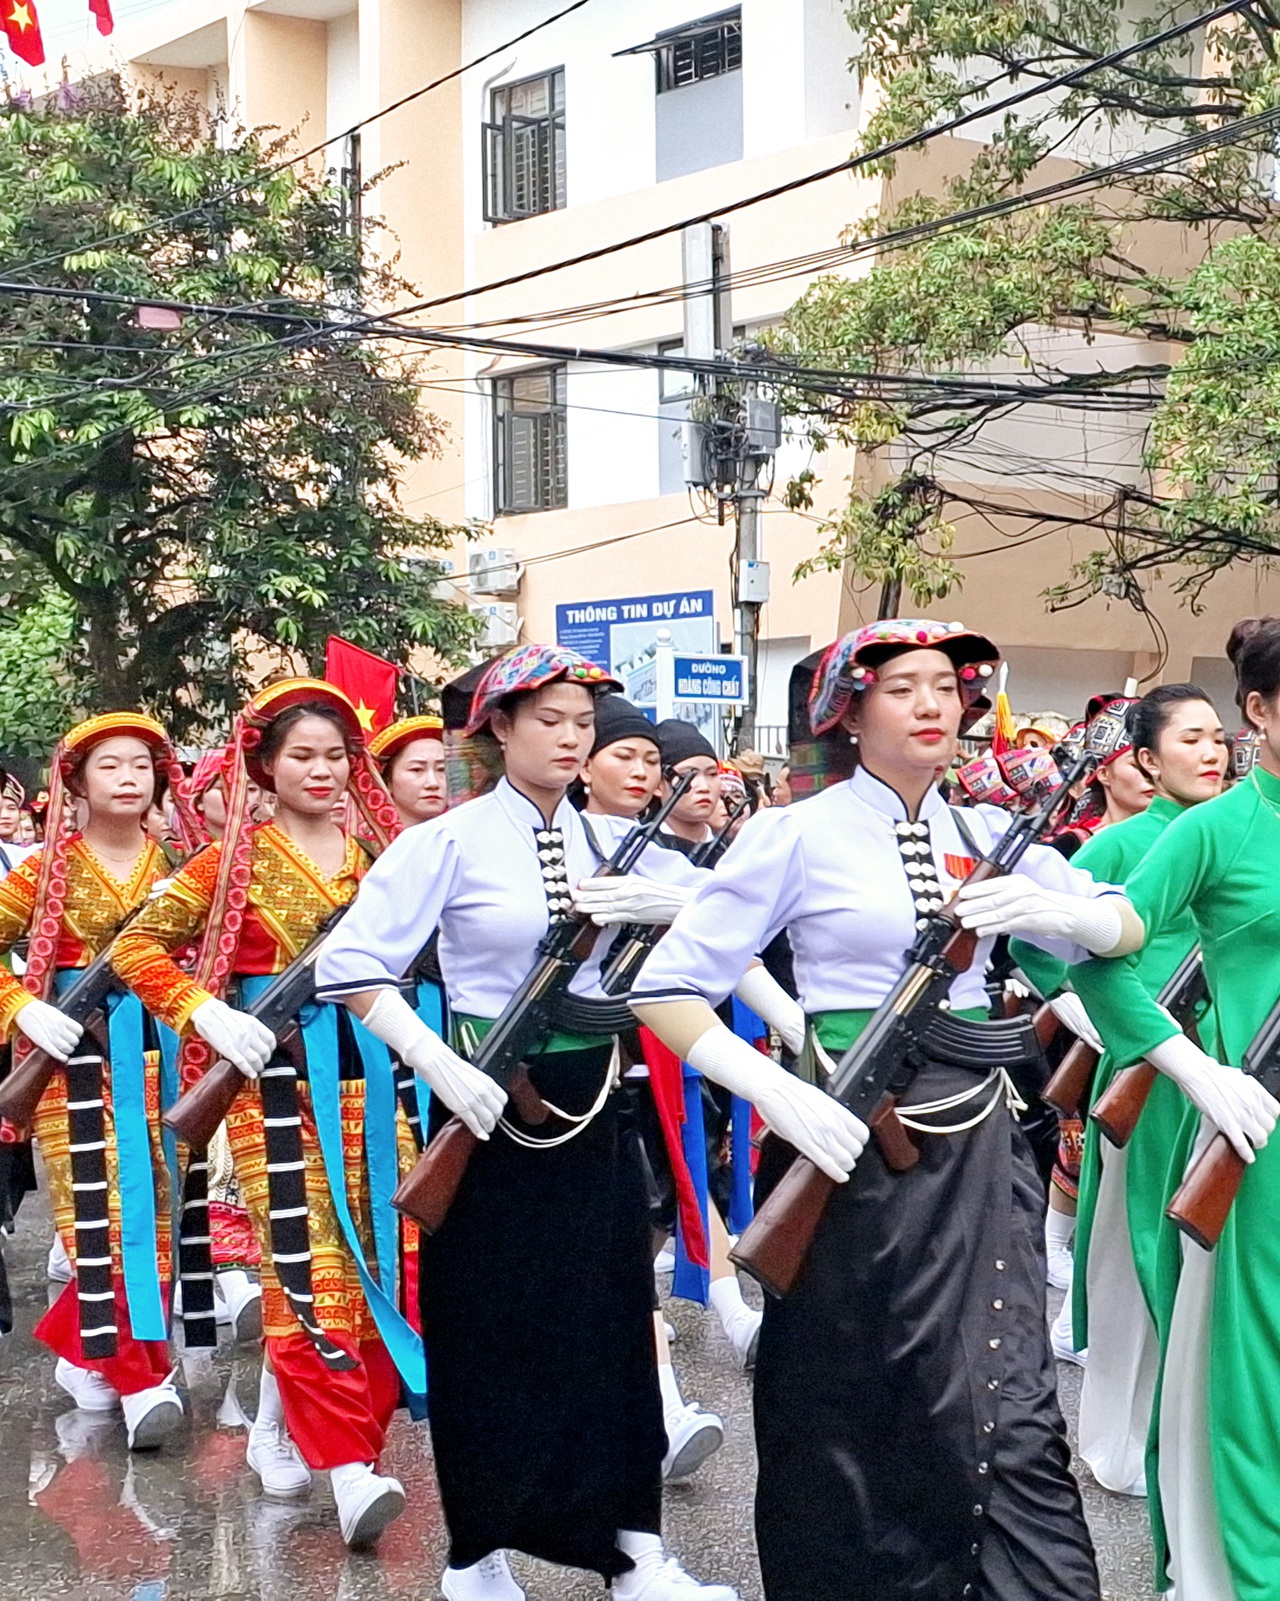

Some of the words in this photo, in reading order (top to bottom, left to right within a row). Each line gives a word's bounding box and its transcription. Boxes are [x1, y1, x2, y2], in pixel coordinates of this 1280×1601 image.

[566, 605, 617, 624] THÔNG
[621, 603, 647, 619] TIN
[652, 599, 676, 618] DỰ
[679, 596, 702, 614] ÁN
